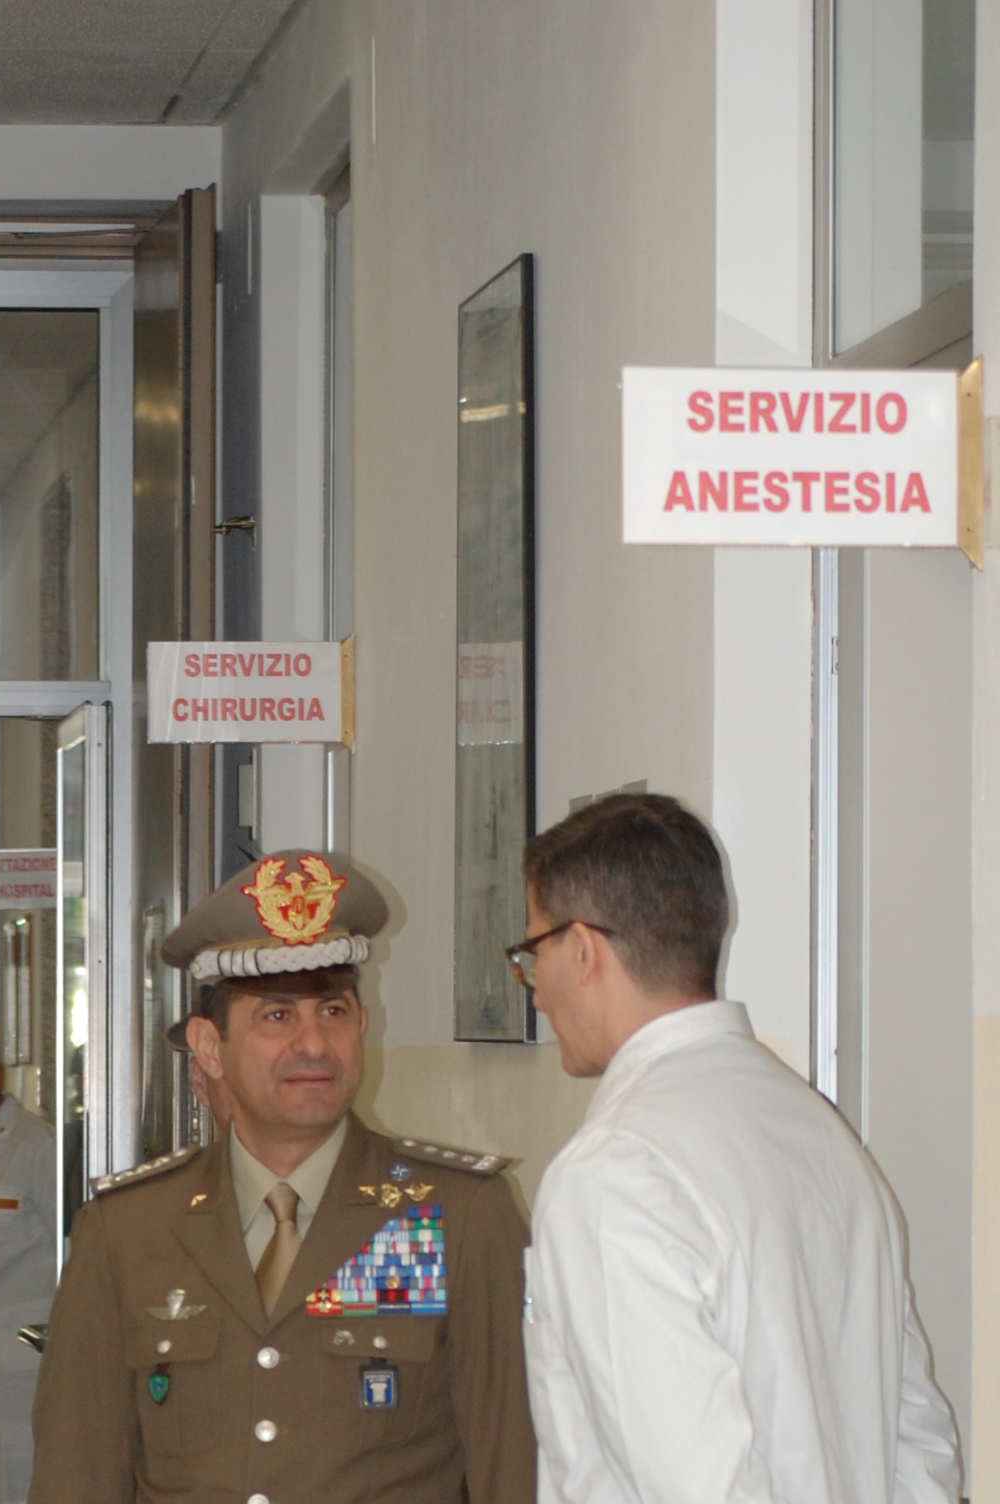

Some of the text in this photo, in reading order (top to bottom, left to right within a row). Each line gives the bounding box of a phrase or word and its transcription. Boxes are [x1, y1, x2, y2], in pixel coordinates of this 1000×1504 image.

[686, 390, 908, 434] SERVIZIO
[663, 470, 933, 515] ANESTESIA
[184, 653, 312, 677] SERVIZIO
[171, 697, 325, 722] CHIRURGIA
